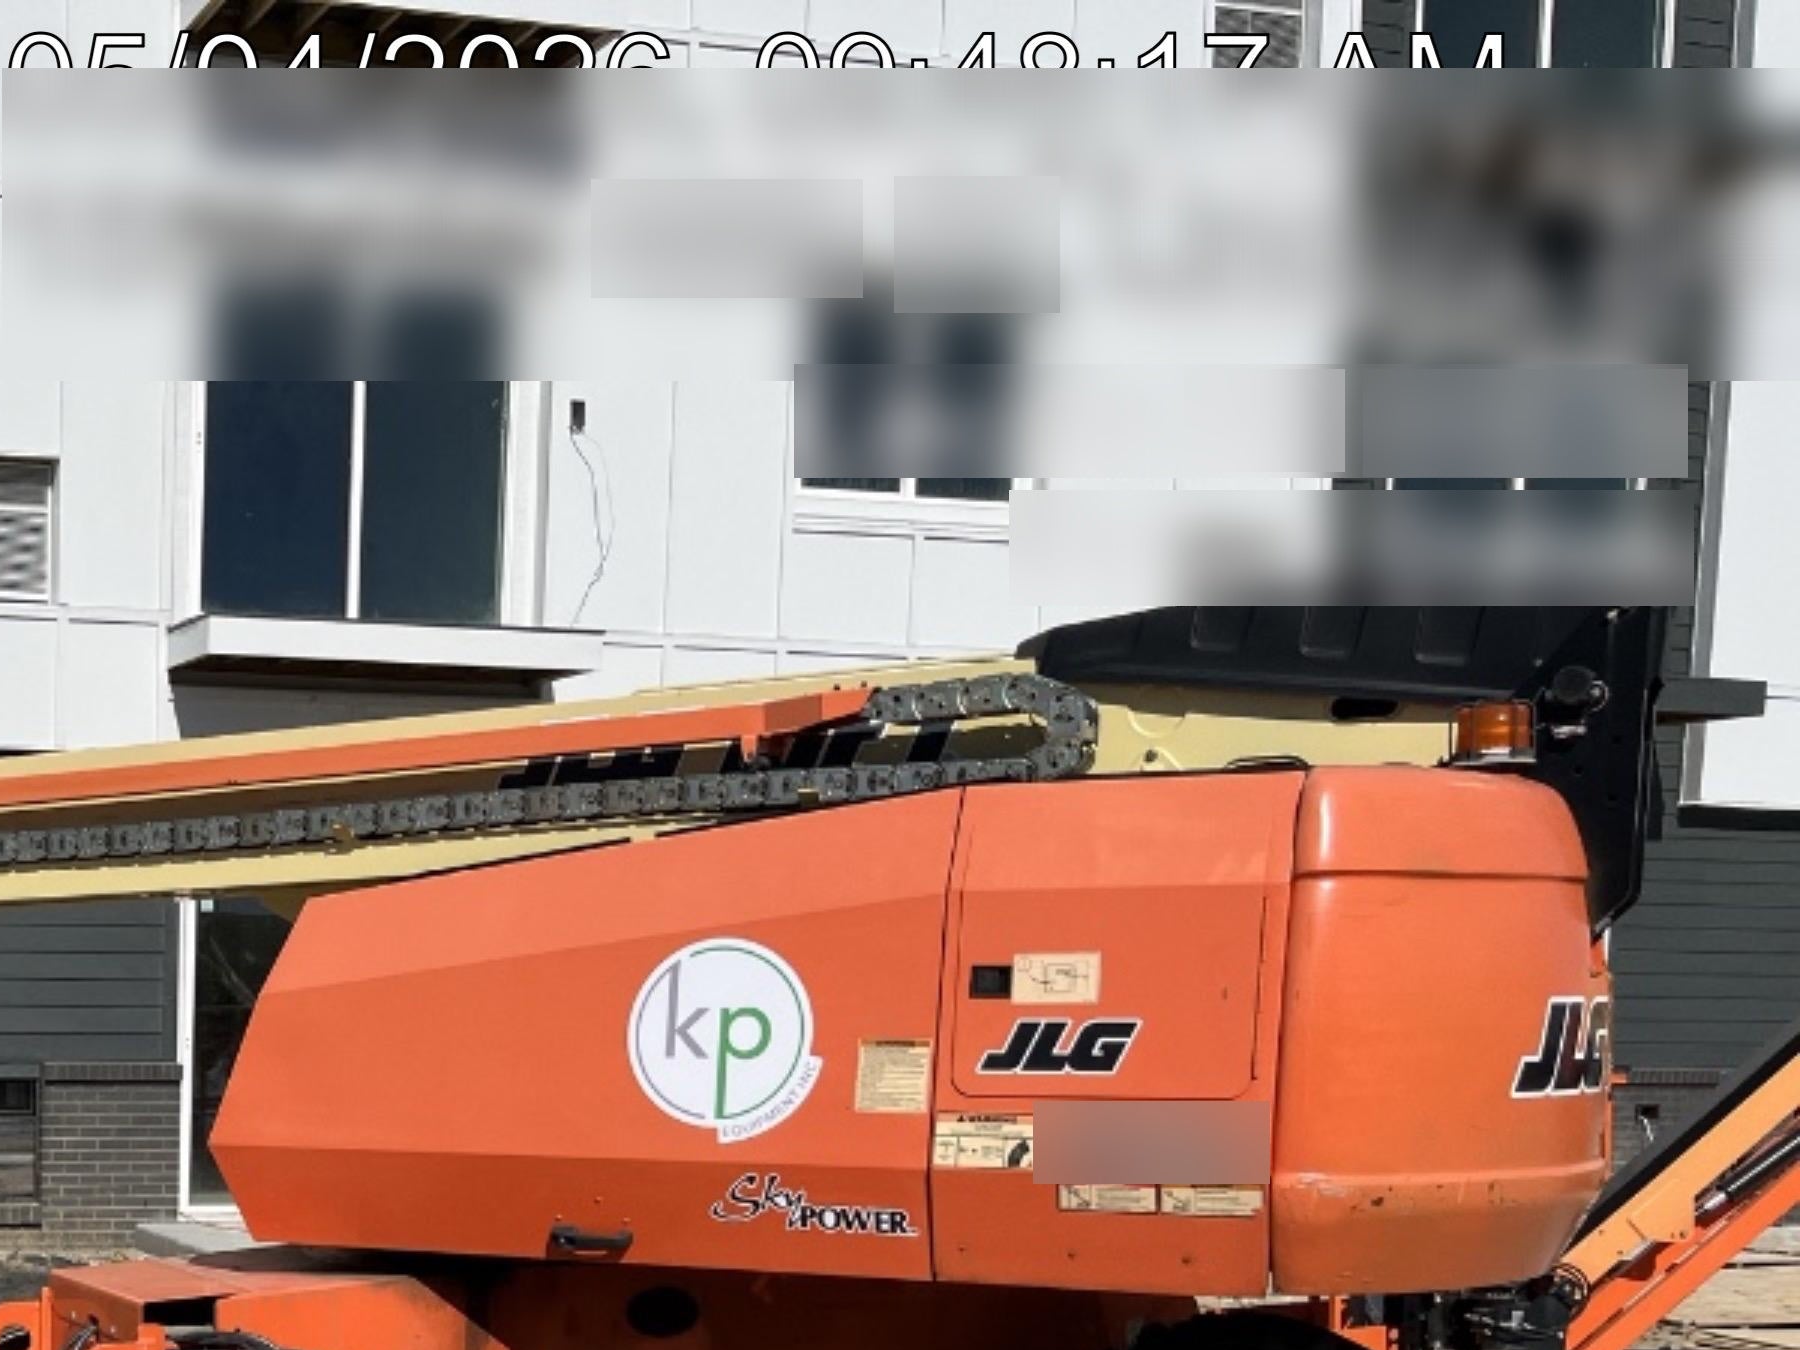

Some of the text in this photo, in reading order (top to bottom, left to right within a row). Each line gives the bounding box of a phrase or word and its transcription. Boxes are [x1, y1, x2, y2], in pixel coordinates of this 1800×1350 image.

[664, 959, 772, 1119] kp
[977, 1018, 1142, 1073] JLG
[722, 1089, 799, 1138] EQUIPMENT
[711, 1173, 806, 1229] Sky
[798, 1205, 910, 1235] POWER
